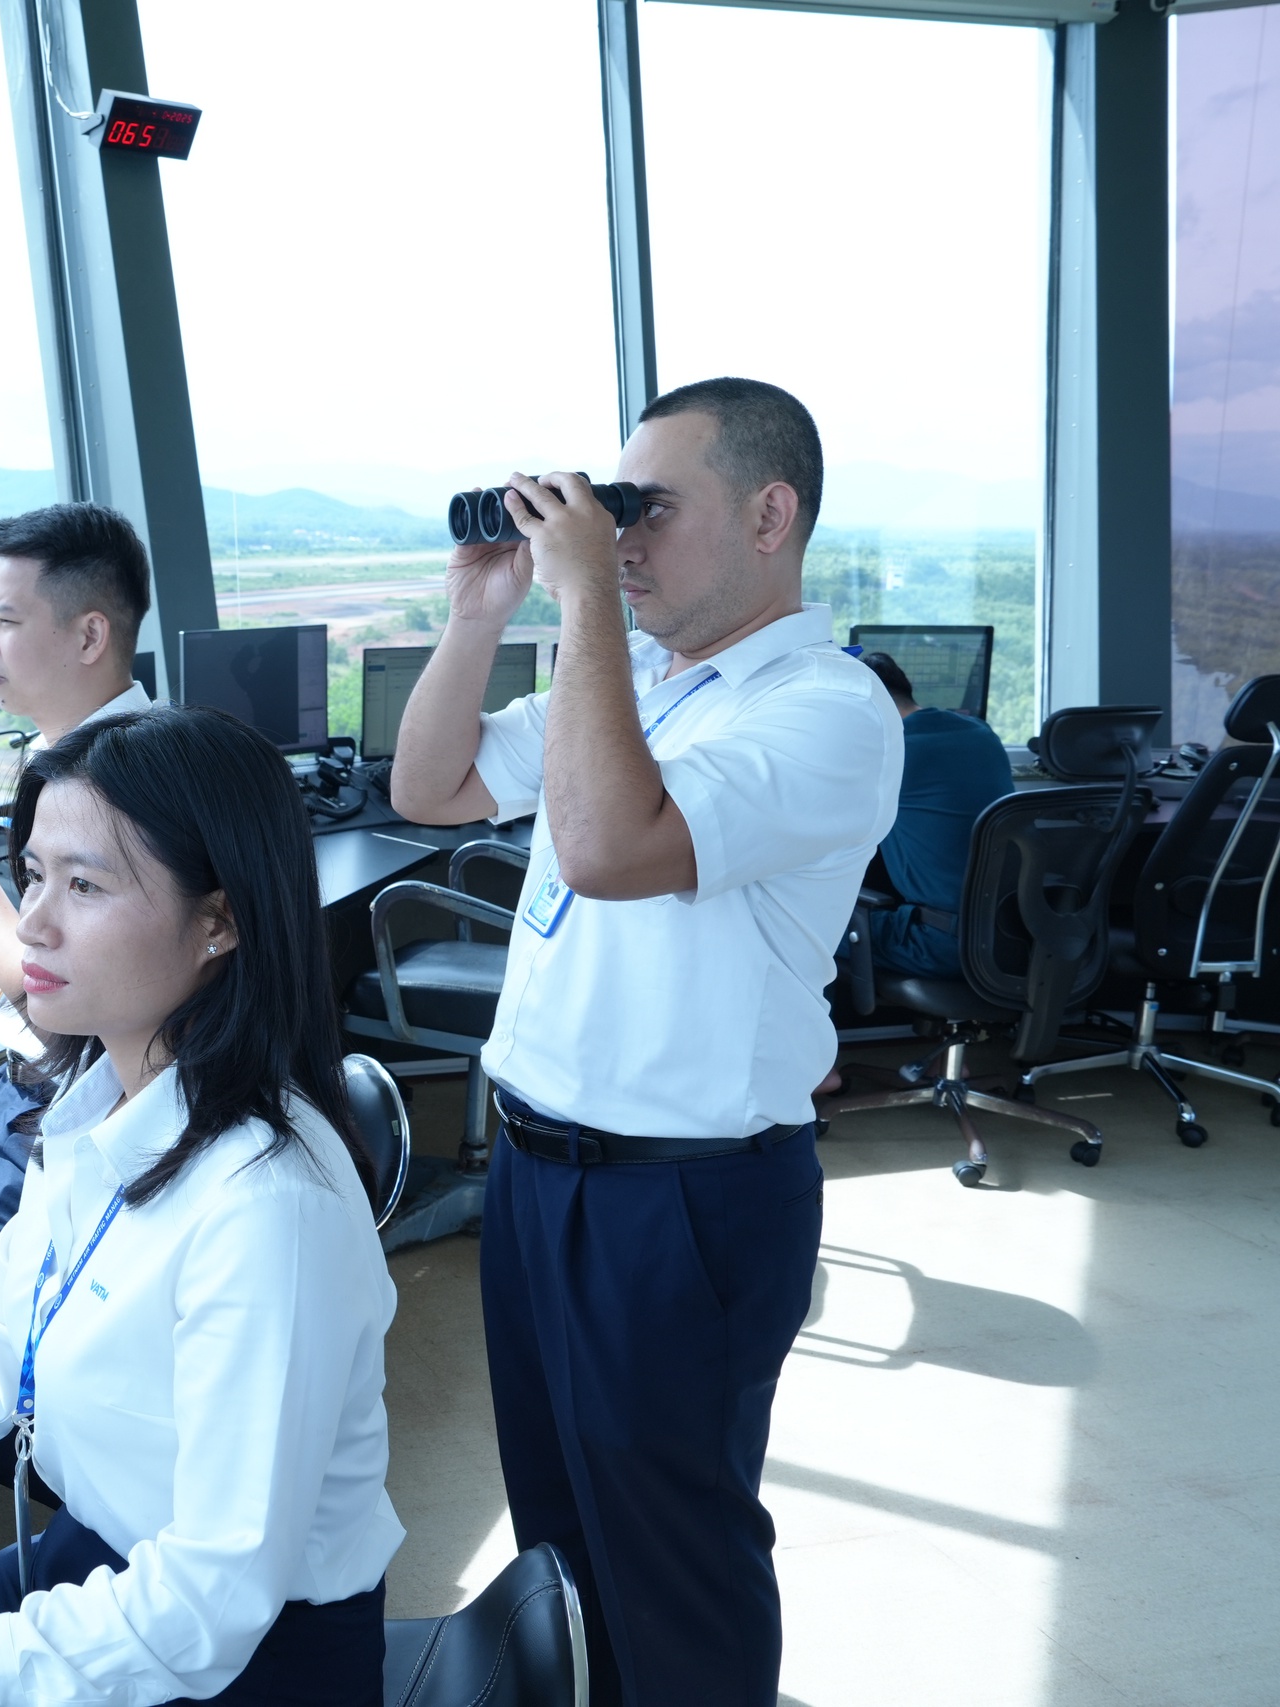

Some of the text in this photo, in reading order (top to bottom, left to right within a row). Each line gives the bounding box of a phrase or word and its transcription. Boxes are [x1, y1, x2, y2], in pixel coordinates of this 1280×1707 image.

[67, 1257, 84, 1286] VIETNAM
[83, 1246, 91, 1259] AIR
[89, 1220, 106, 1246] TRAFFIC
[89, 1278, 110, 1303] VATM
